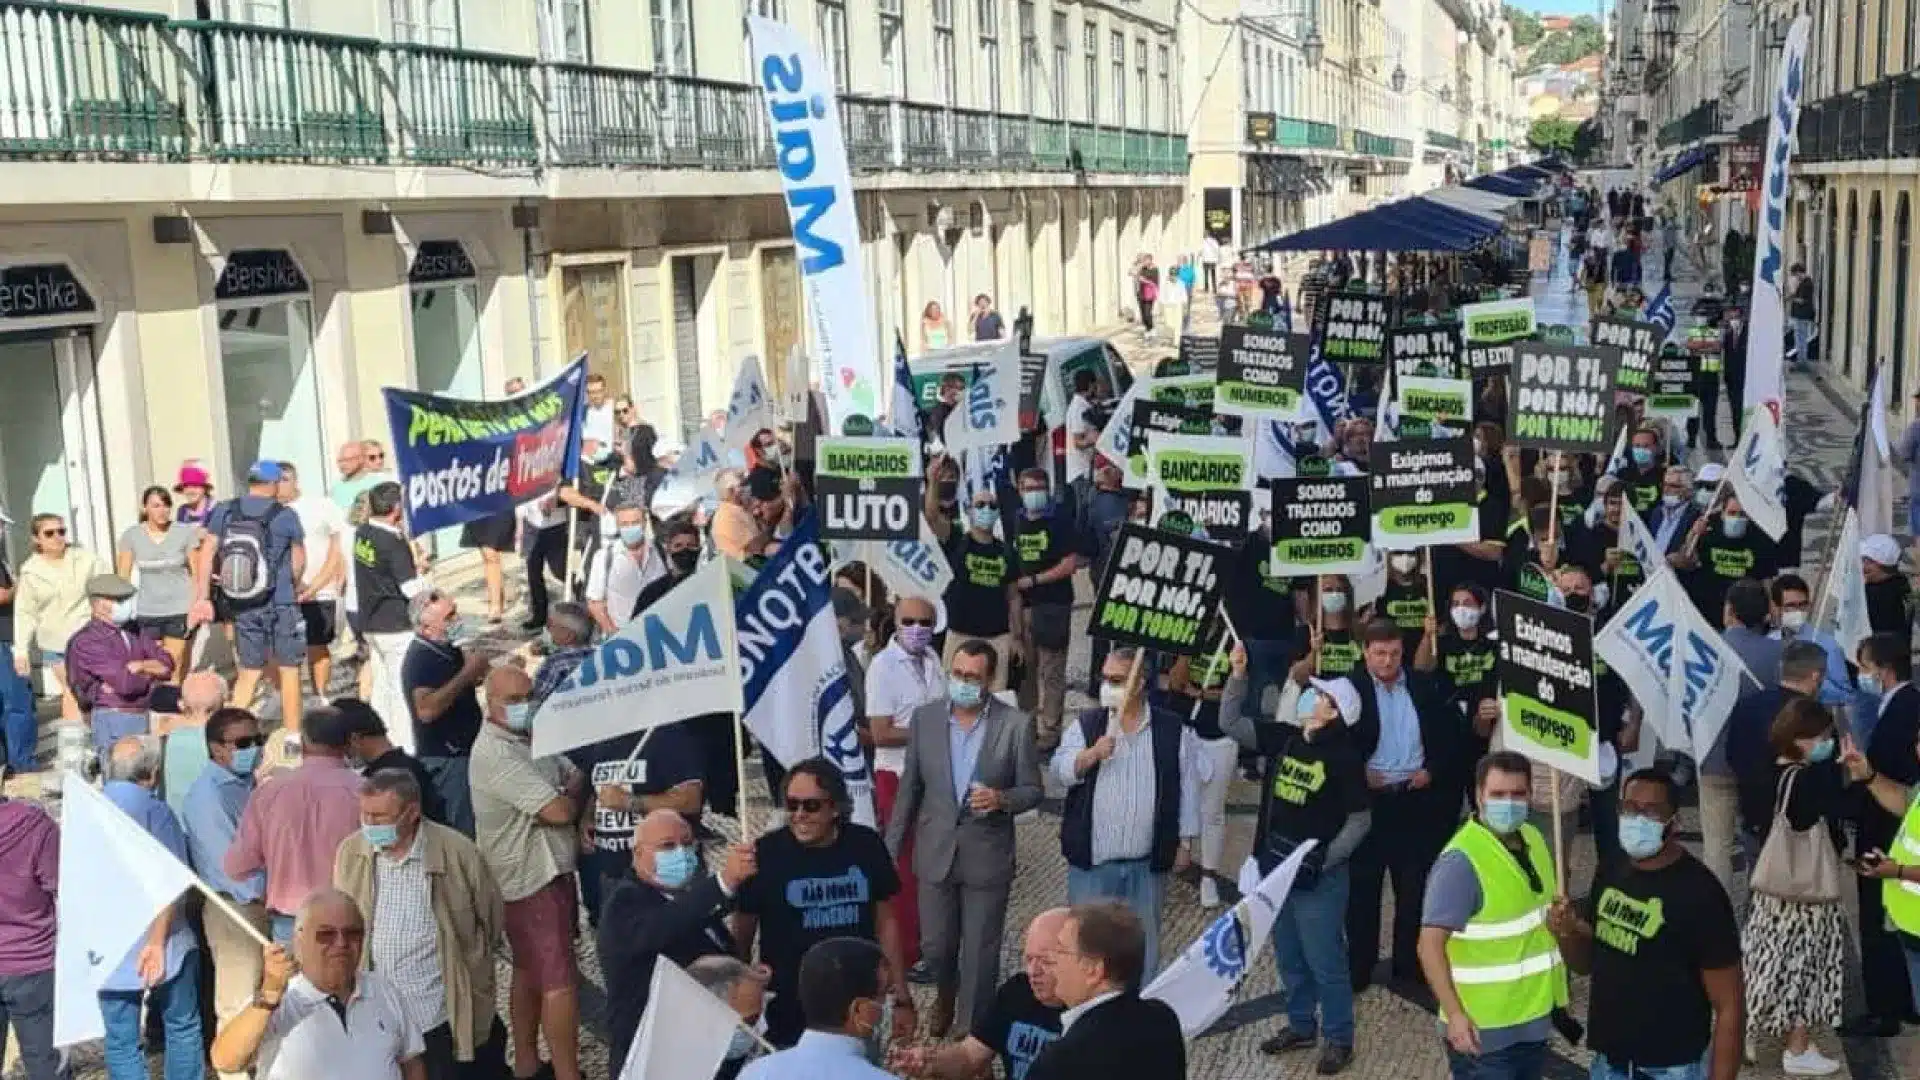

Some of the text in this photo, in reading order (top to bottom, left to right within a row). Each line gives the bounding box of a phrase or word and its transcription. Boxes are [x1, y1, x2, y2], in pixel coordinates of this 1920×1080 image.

[225, 253, 300, 293] Bershka
[0, 274, 78, 318] ershka
[1330, 298, 1363, 321] POR
[1243, 334, 1285, 352] SOMOS
[1394, 333, 1429, 356] POR
[1597, 321, 1631, 348] POR
[1243, 367, 1279, 384] COMO
[1520, 353, 1608, 392] POR TI,
[1518, 387, 1558, 413] POR
[1515, 414, 1547, 438] POR
[1391, 450, 1454, 471] Exigimos
[410, 457, 483, 517] postos
[485, 446, 510, 495] de
[1374, 465, 1474, 489] a manutenção
[1297, 483, 1346, 501] SOMOS
[826, 494, 909, 532] LUTO
[1285, 500, 1356, 519] TRATADOS
[1394, 509, 1456, 529] emprego
[1300, 520, 1342, 537] COMO
[1288, 539, 1355, 560] NÚMEROS
[1119, 536, 1217, 592] POR TI,
[1109, 573, 1157, 608] POR
[1101, 601, 1139, 632] POR
[1515, 613, 1573, 655] Exigimos
[1501, 641, 1510, 661] a
[1512, 644, 1592, 691] manutenção
[1520, 707, 1576, 747] emprego
[593, 764, 639, 782] ESTU
